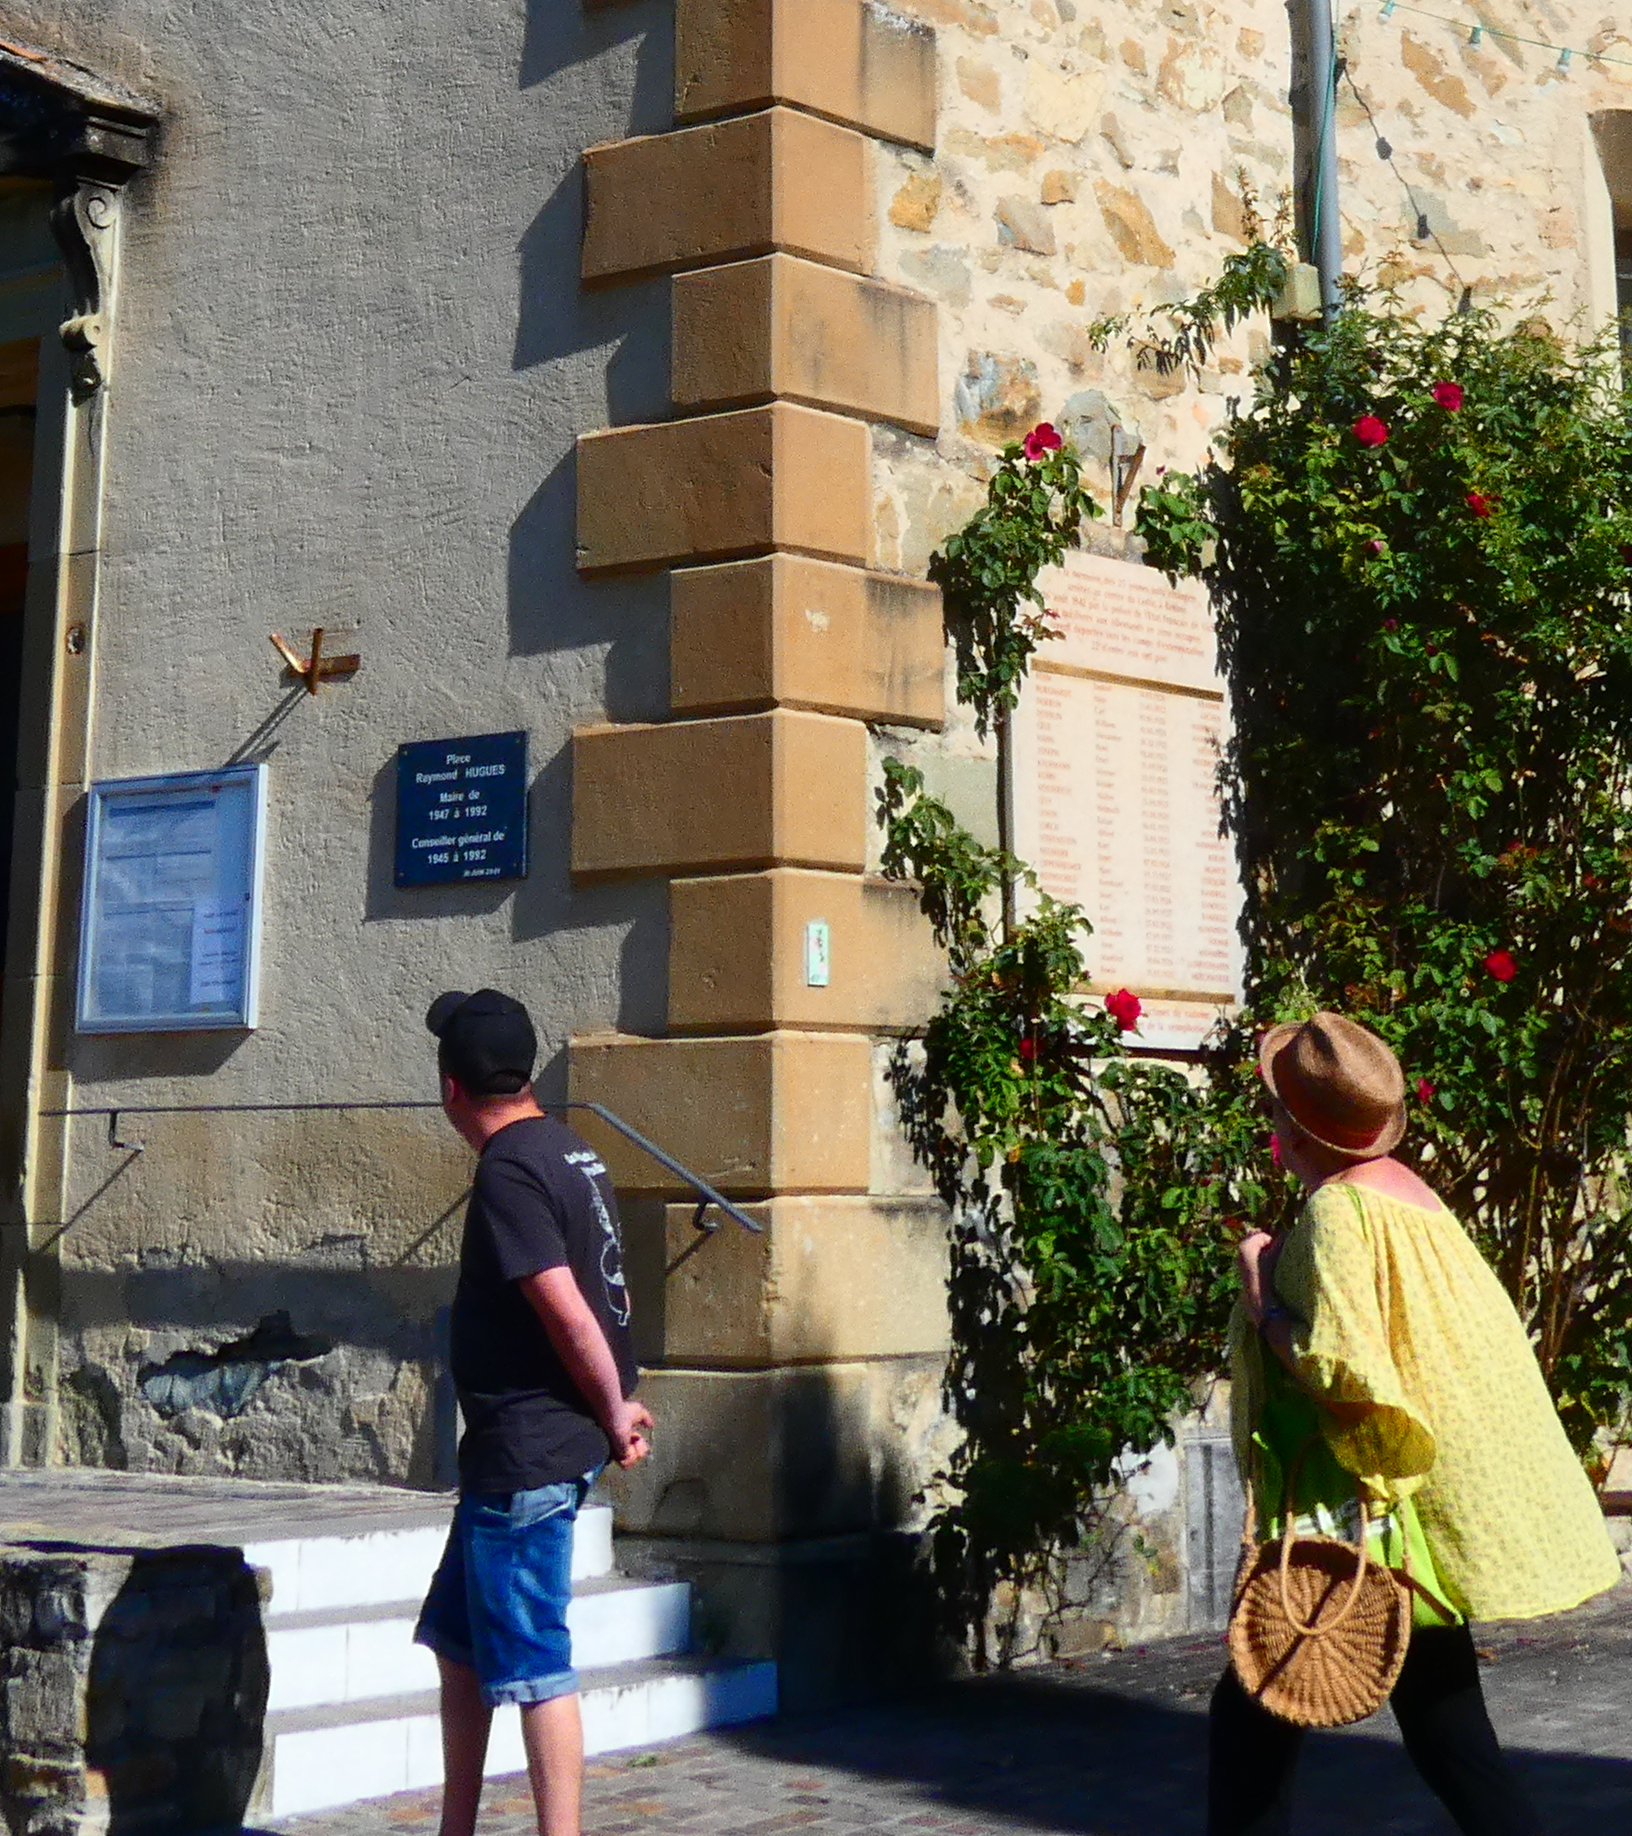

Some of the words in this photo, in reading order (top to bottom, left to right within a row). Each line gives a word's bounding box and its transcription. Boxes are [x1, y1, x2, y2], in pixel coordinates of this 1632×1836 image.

[446, 754, 471, 764] Place
[416, 770, 458, 784] Raymond
[465, 764, 506, 778] HUGUES
[440, 791, 464, 802] Maire
[468, 790, 480, 800] de
[429, 809, 449, 820] 1947
[465, 805, 487, 817] 1992
[412, 836, 456, 848] Conseiller
[493, 831, 505, 841] de
[463, 849, 486, 861] 1992
